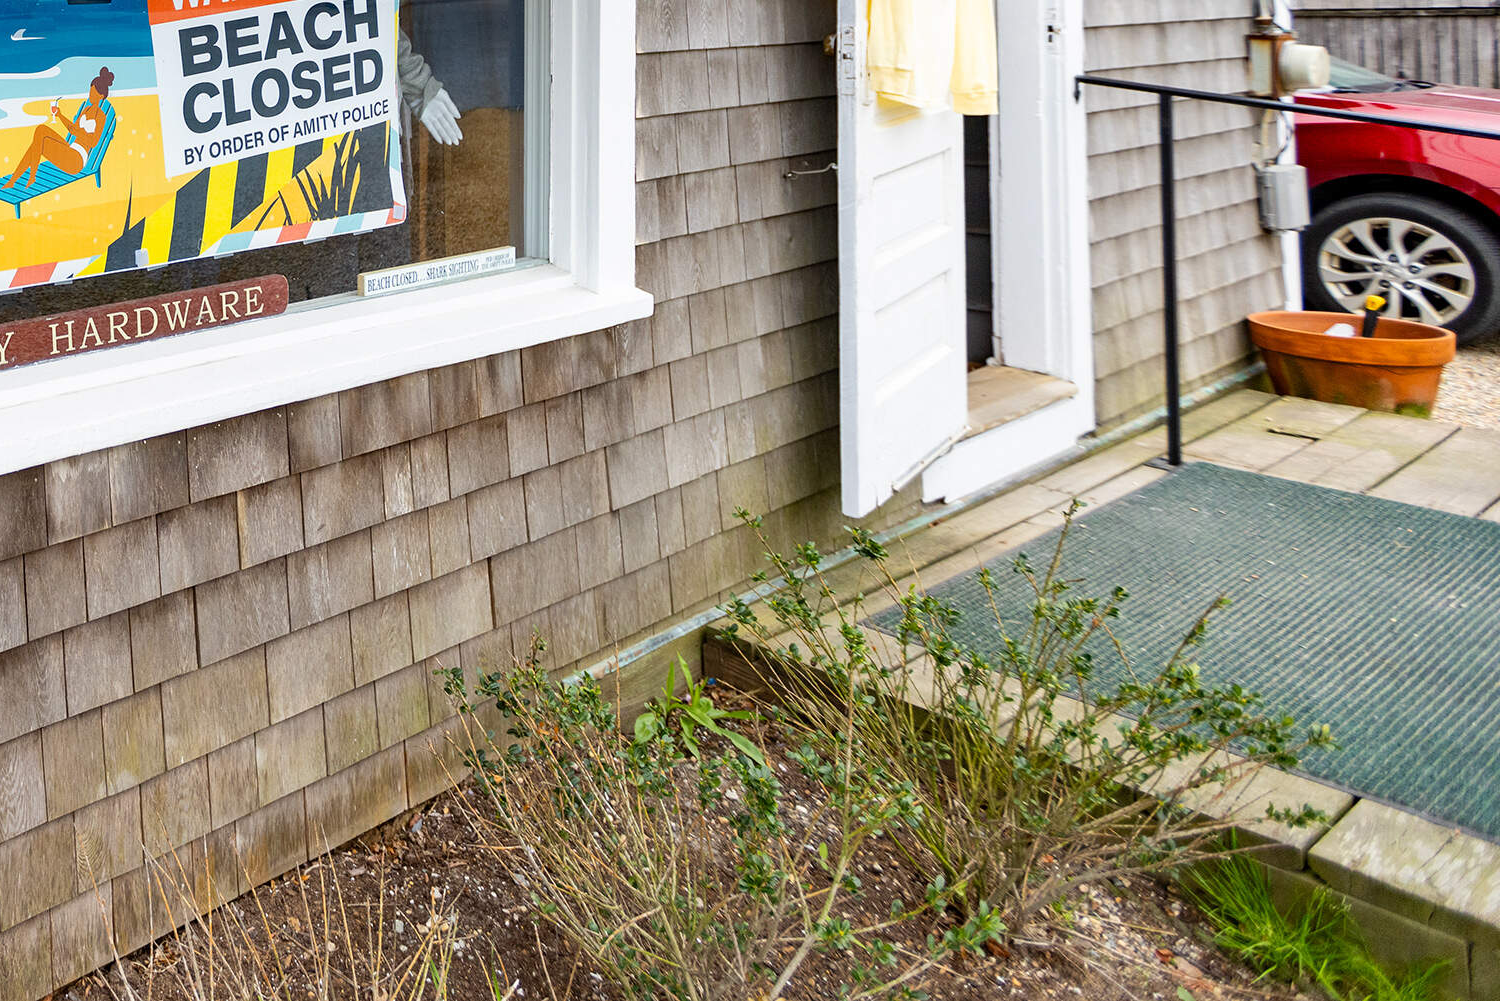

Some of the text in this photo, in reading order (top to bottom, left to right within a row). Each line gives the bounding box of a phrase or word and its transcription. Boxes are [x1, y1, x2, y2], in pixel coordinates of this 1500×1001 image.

[182, 48, 384, 134] CLOSED
[184, 100, 390, 166] BY ORDER OF AMITY POLICE
[367, 276, 391, 292] BEACH
[426, 264, 448, 281] SHARK
[448, 259, 480, 276] SIGHTING
[49, 286, 265, 355] HARDWARE
